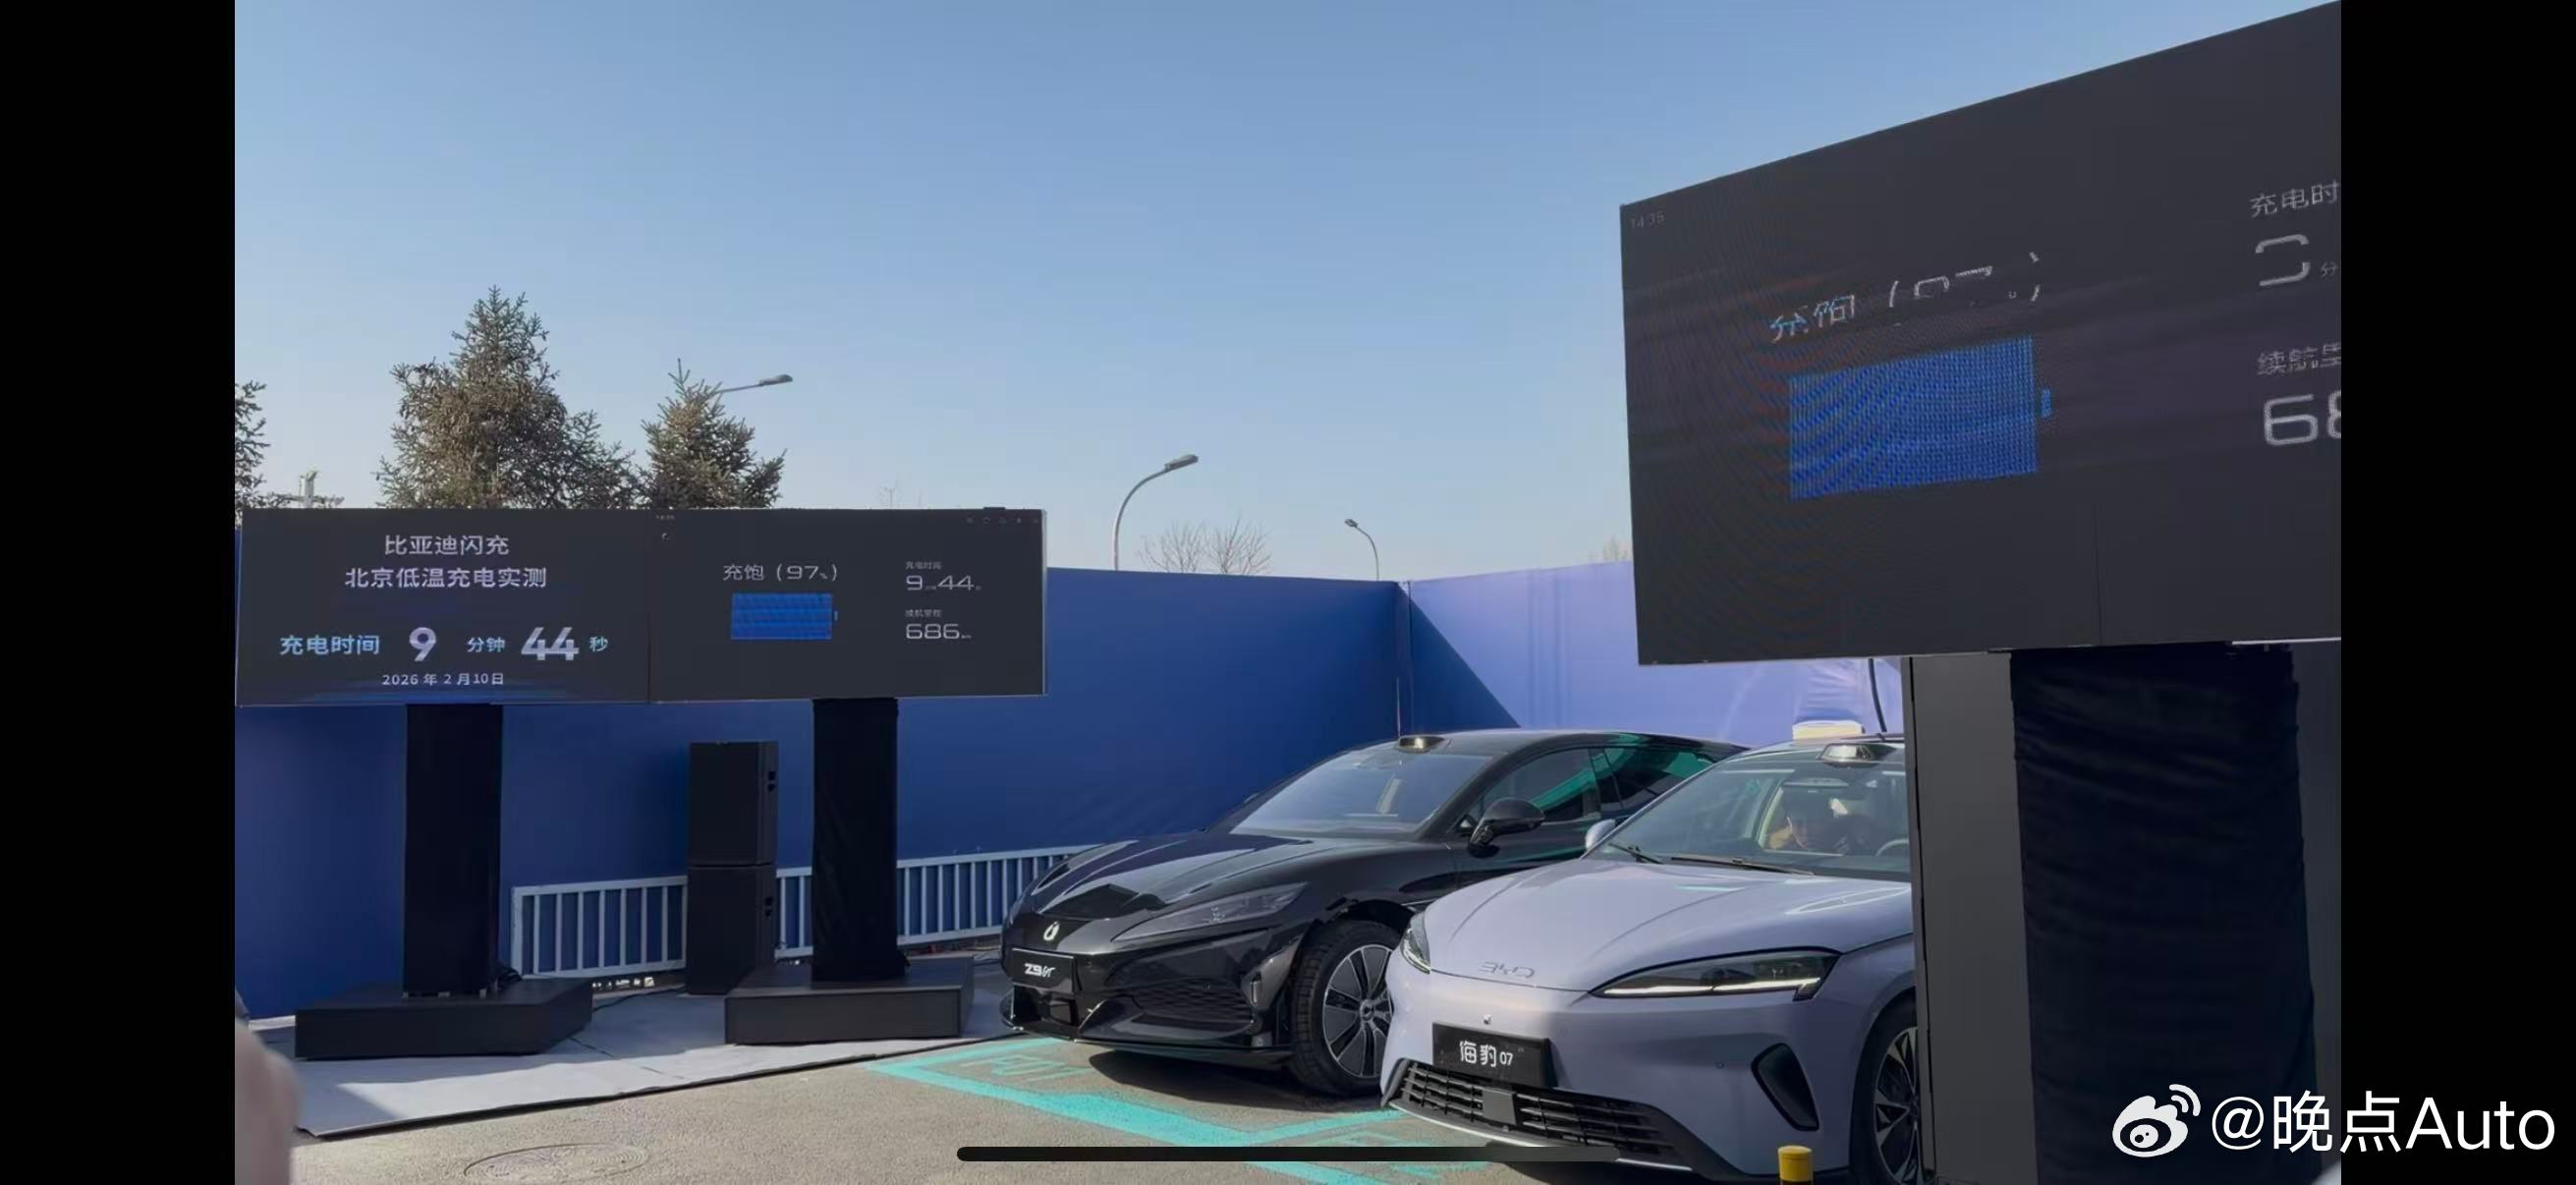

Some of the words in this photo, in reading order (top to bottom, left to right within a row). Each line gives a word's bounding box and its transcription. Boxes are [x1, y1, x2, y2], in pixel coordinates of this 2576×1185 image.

[384, 535, 510, 556] 比亚迪闪充
[345, 566, 547, 589] 北京低温充电实测
[723, 563, 764, 582] 充饱
[906, 623, 960, 640] 686
[280, 634, 380, 655] 充电时间
[409, 626, 437, 662] 9
[467, 636, 506, 653] 分钟
[521, 626, 580, 661] 44
[588, 636, 609, 652] 秒
